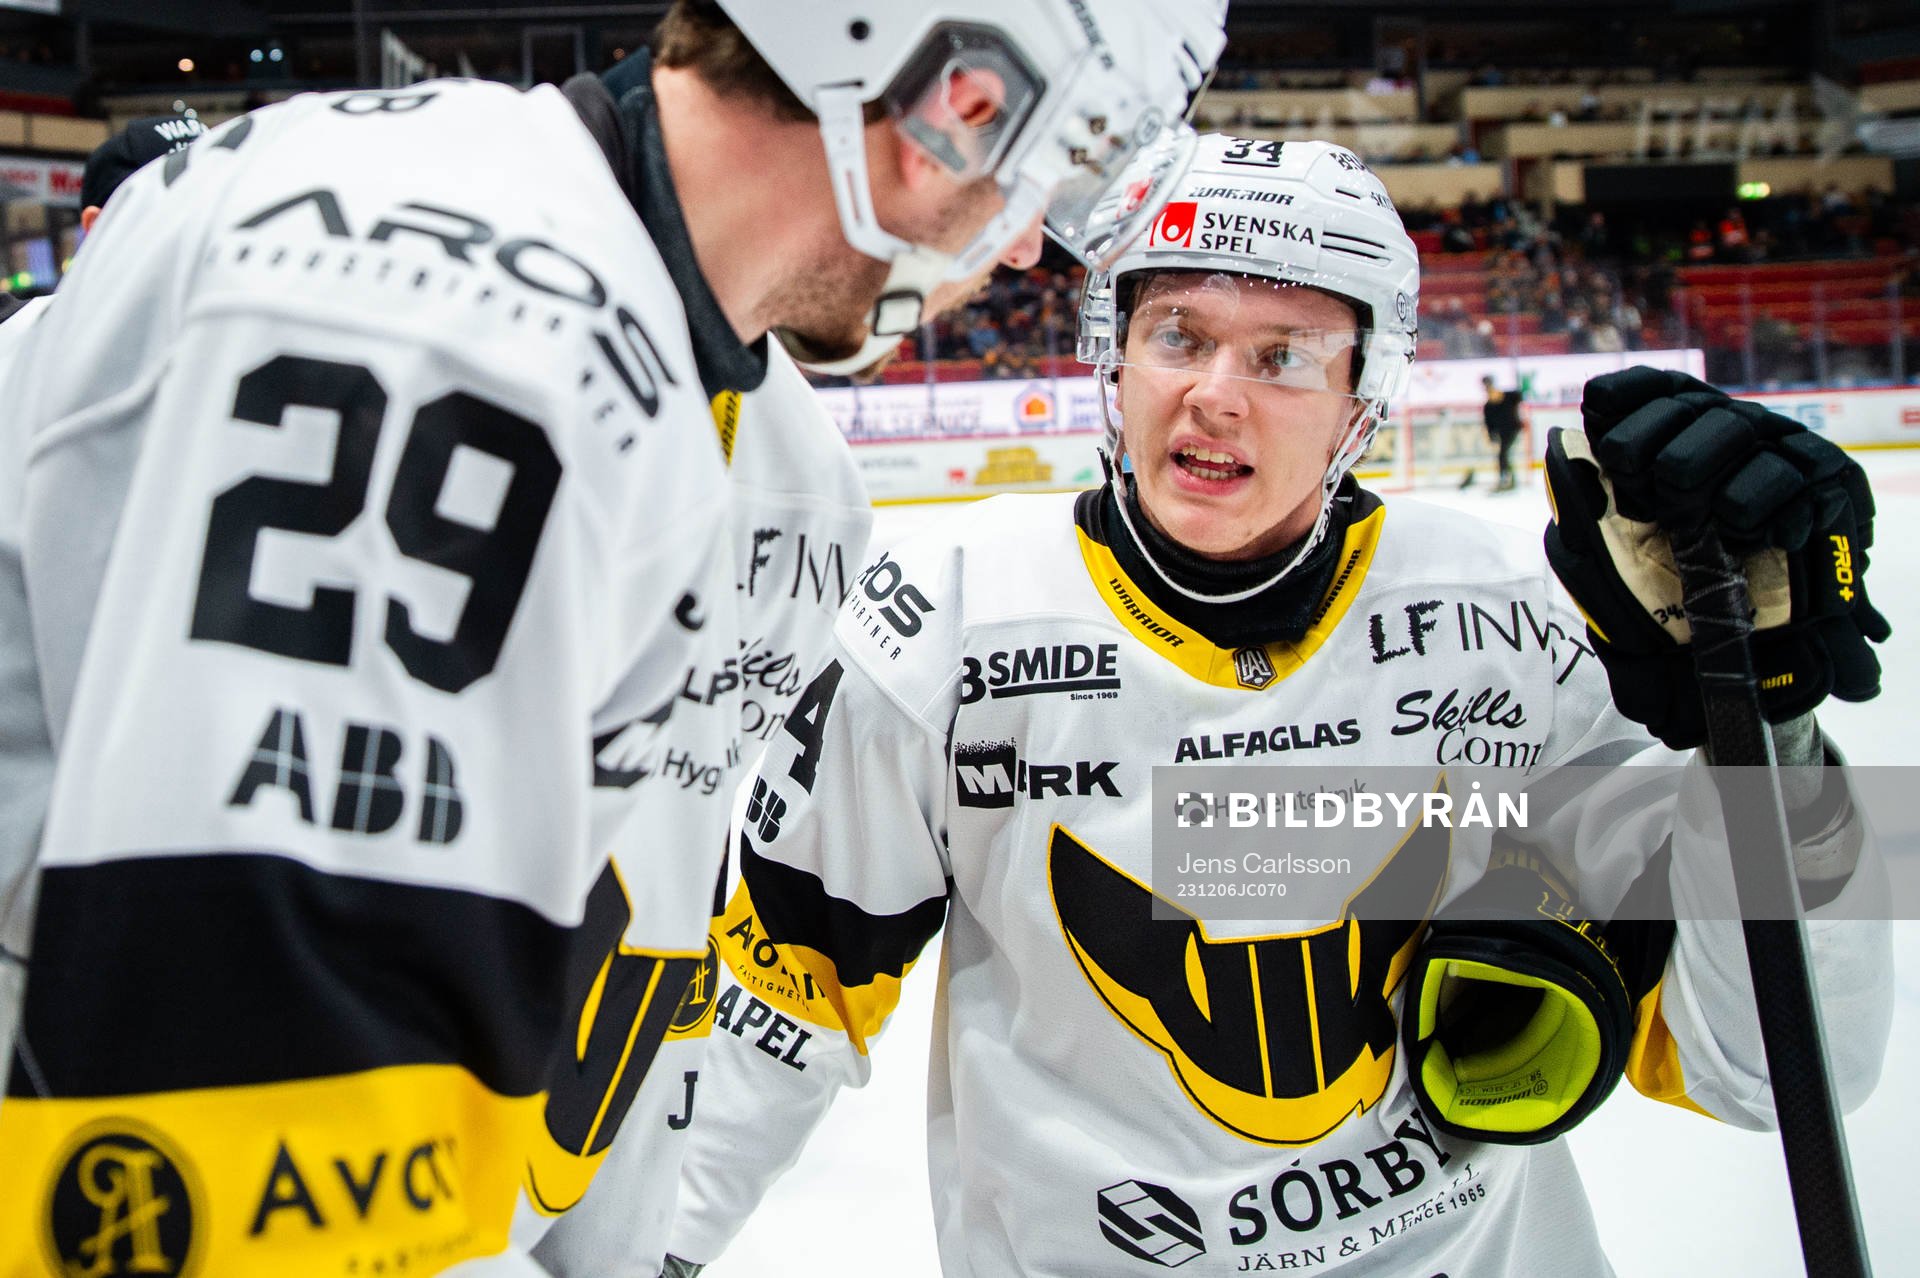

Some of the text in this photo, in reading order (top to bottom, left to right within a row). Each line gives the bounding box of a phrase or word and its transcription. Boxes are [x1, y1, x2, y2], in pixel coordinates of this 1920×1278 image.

[1224, 138, 1285, 163] 34
[1188, 186, 1295, 206] WARRIOR
[1200, 233, 1257, 255] SPEL
[1203, 212, 1315, 245] SVENSKA
[236, 189, 678, 418] AROS
[187, 354, 563, 695] 29
[1311, 549, 1362, 627] WARRIOR
[1829, 535, 1854, 602] PRO+
[1109, 577, 1185, 648] WARRIOR
[1368, 600, 1444, 665] LF
[1070, 691, 1119, 701] Since 1969
[1390, 687, 1528, 736] Skills
[1174, 718, 1361, 763] ALFAGLAS
[1449, 1183, 1486, 1209] 1965
[1237, 1243, 1327, 1272] JÄRN
[1338, 1236, 1361, 1257] &
